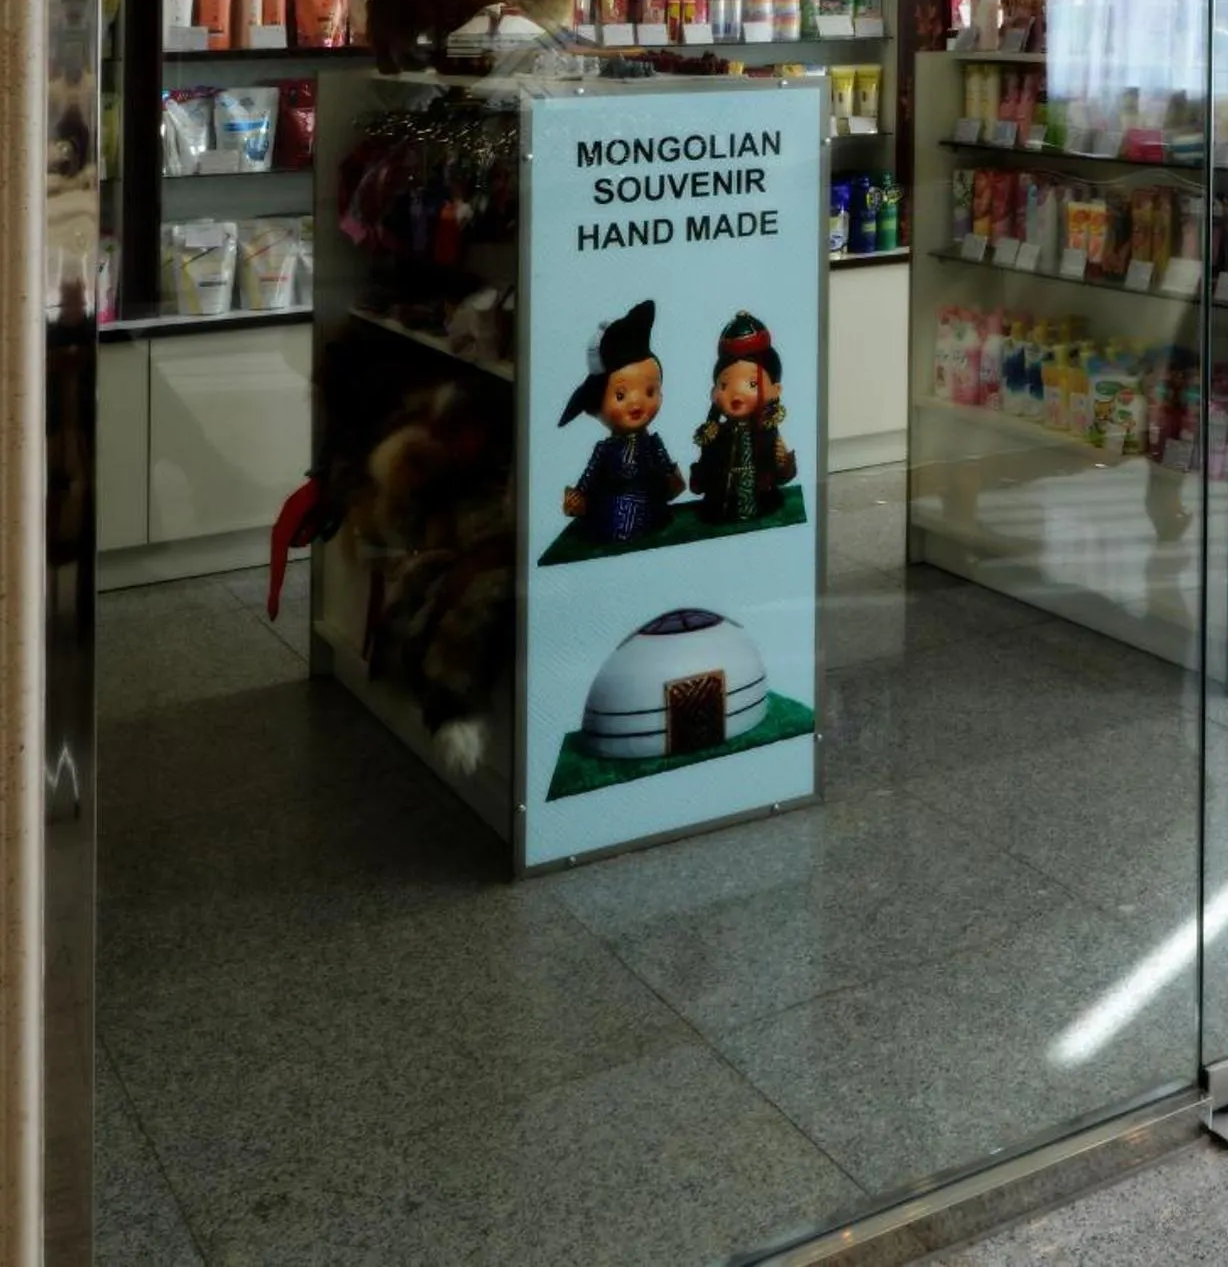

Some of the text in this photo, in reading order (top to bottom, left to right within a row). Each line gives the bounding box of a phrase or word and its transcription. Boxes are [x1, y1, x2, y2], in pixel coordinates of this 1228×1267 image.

[576, 130, 782, 168] MONGOLIAN
[593, 168, 767, 205] SOUVENIR
[576, 209, 779, 252] HAND MADE
